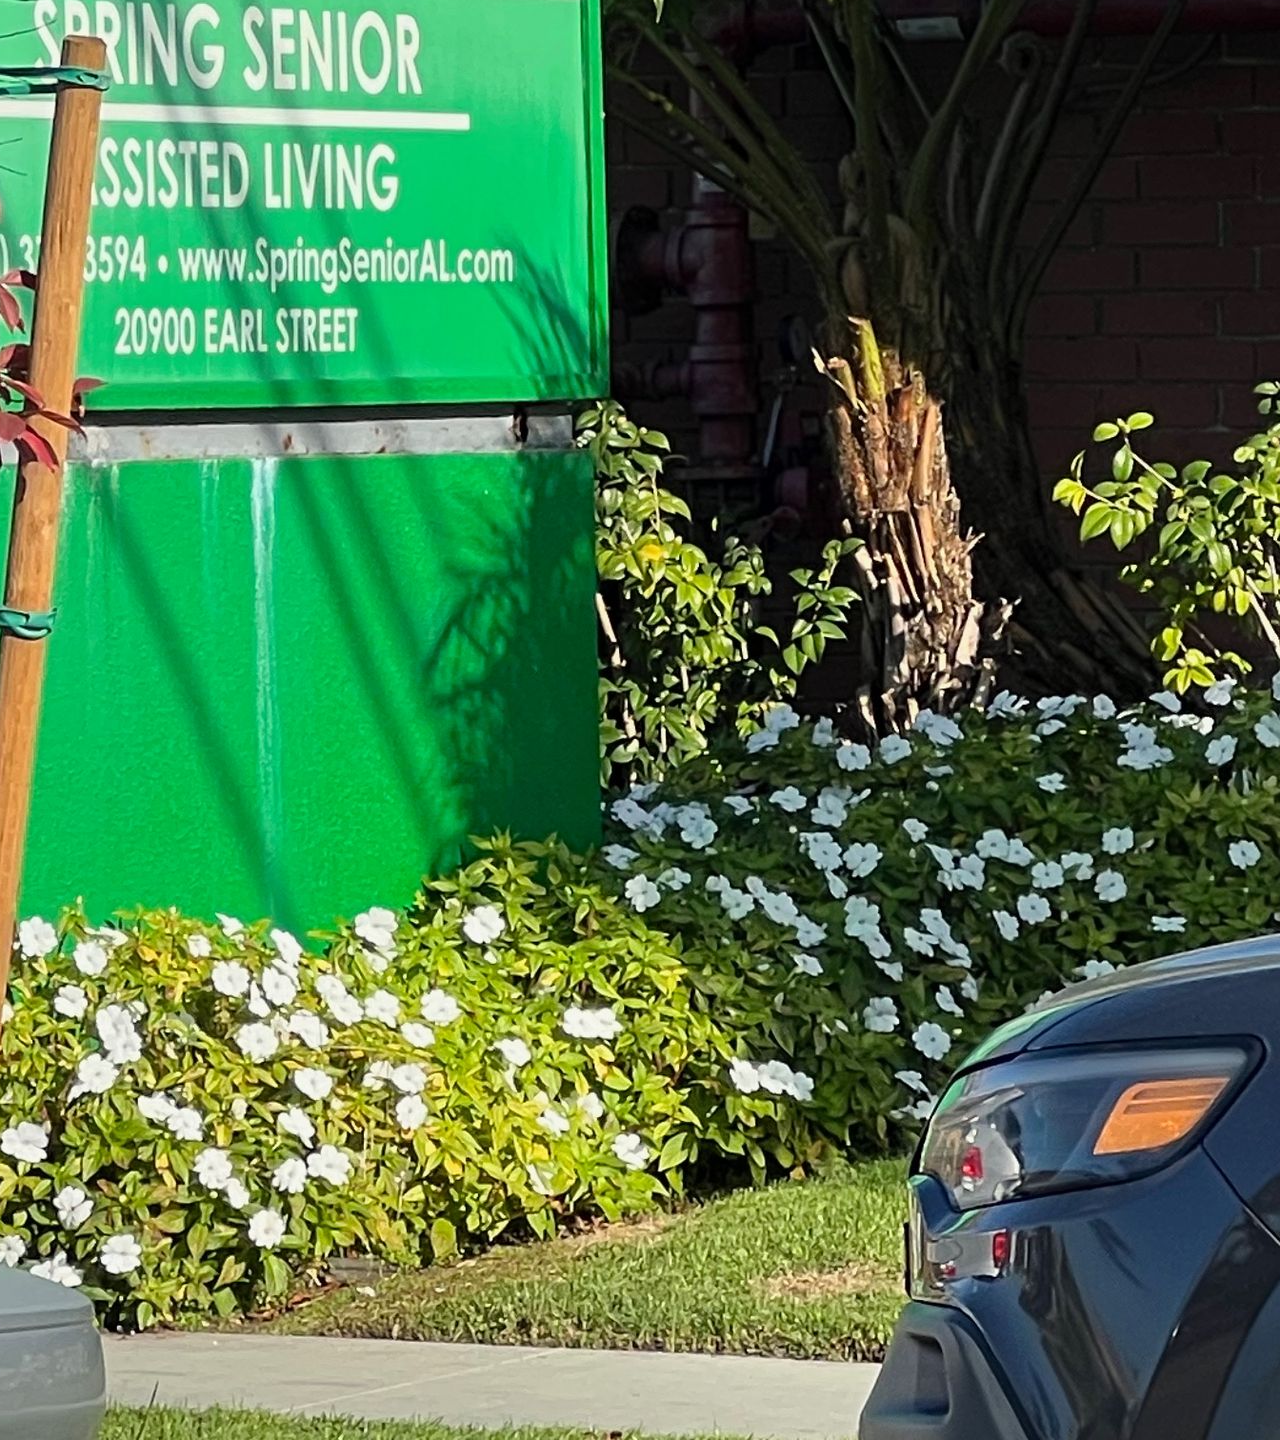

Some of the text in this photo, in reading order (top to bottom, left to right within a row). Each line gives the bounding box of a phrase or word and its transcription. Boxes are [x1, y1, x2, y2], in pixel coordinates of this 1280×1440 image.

[243, 5, 423, 95] SENIOR
[91, 137, 399, 211] SSISTED LIVING
[178, 236, 514, 294] www.SpringSeniorAL.com
[114, 307, 358, 355] 20900 EARL STREET
